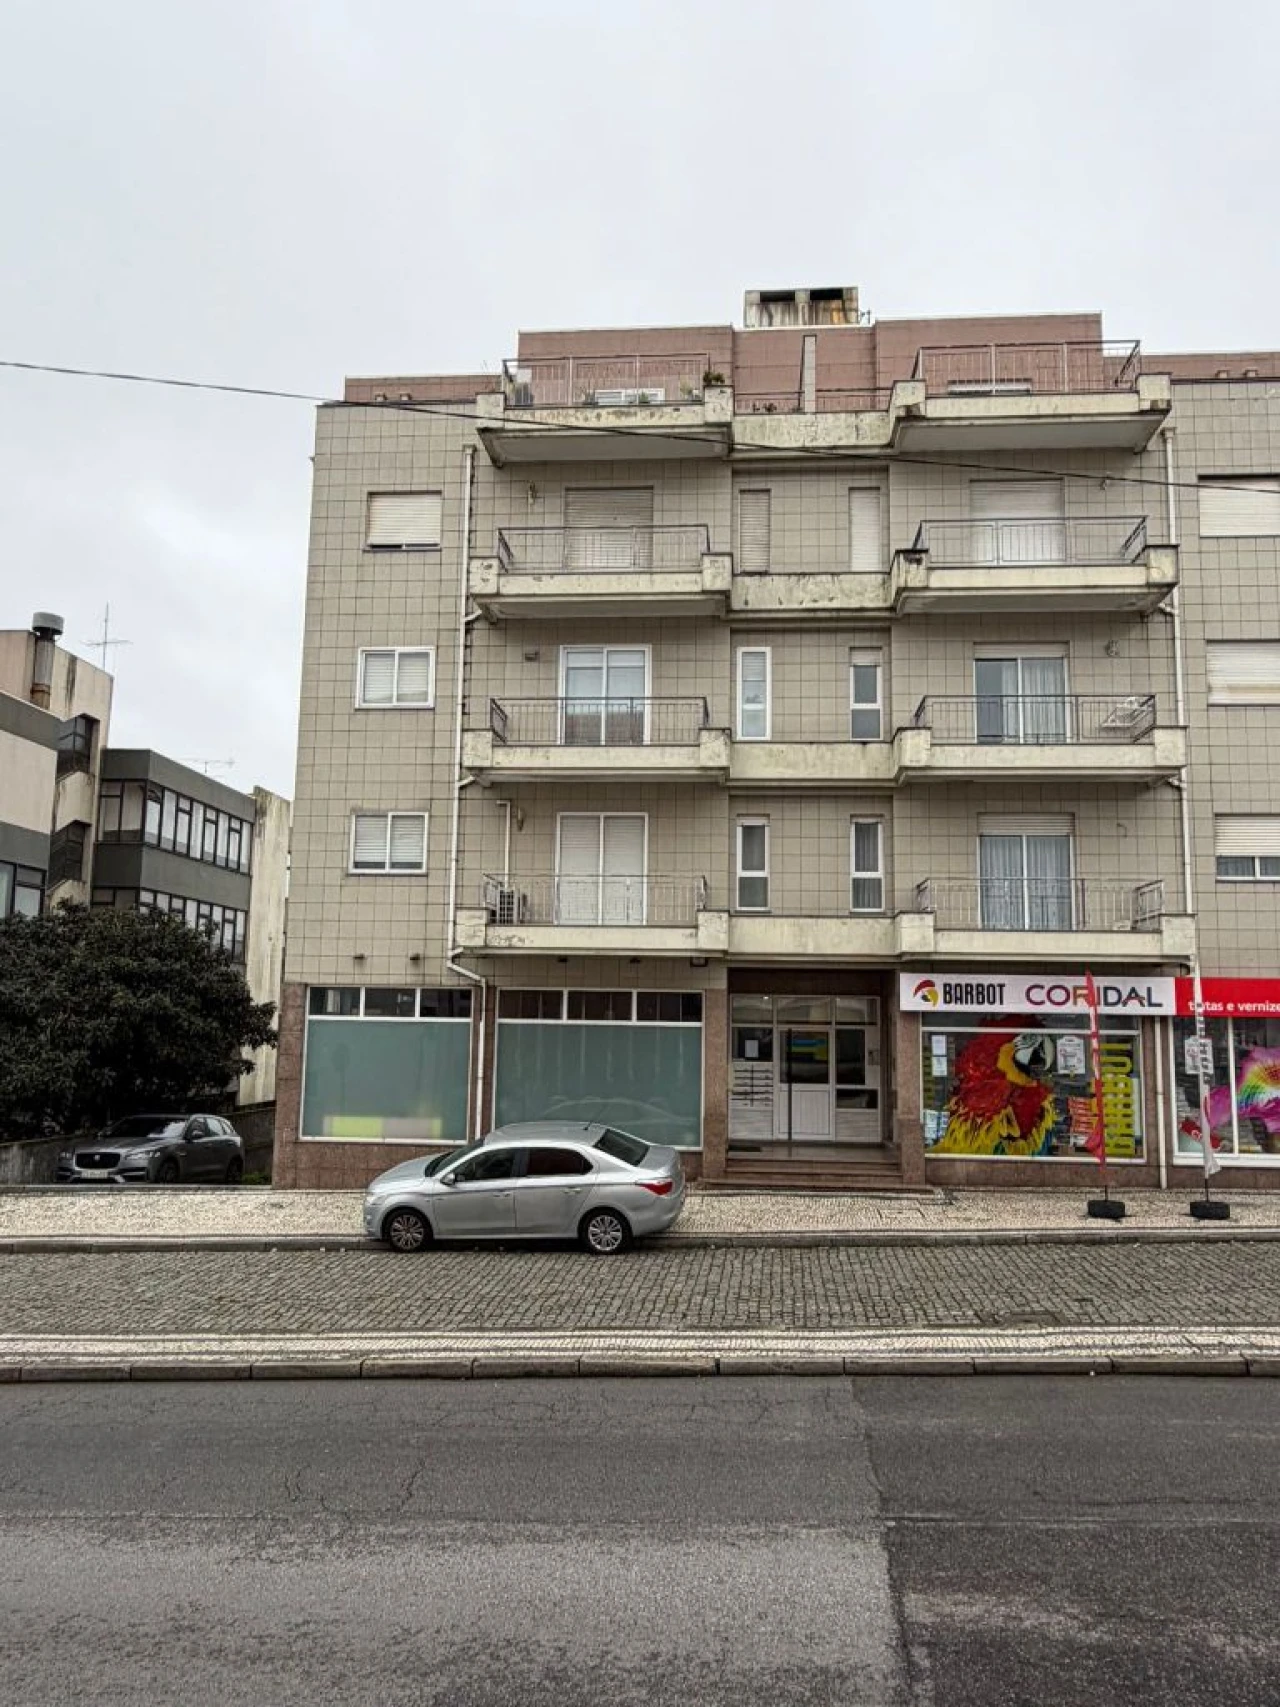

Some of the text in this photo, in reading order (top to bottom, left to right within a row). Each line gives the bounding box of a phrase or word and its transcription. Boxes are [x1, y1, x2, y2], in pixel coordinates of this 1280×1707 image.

[942, 982, 1006, 1006] BARBOT
[1188, 1000, 1224, 1011] ttas
[1226, 1001, 1236, 1011] e
